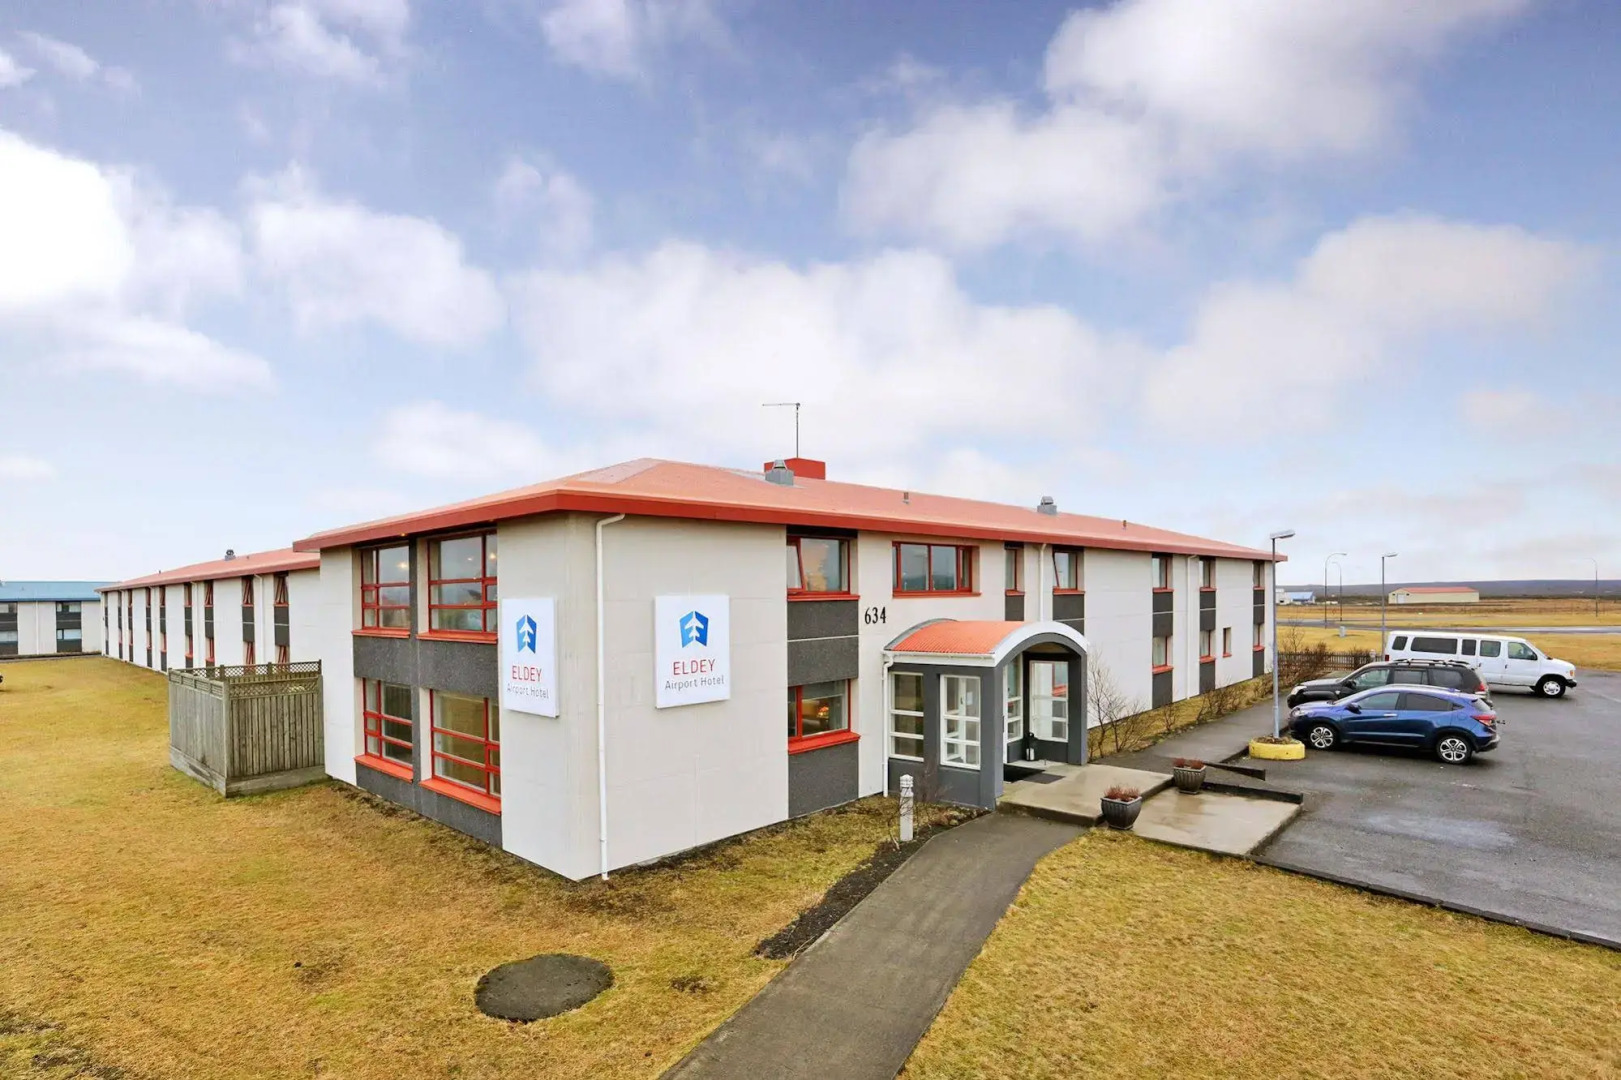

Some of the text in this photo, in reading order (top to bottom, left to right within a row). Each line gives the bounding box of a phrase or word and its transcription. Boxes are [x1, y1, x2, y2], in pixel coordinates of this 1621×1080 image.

[864, 606, 886, 624] 634
[512, 665, 542, 682] ELDEY
[673, 658, 716, 676] ELDEY
[507, 683, 549, 699] Airport Hotel
[664, 675, 725, 692] Airport Hotel
